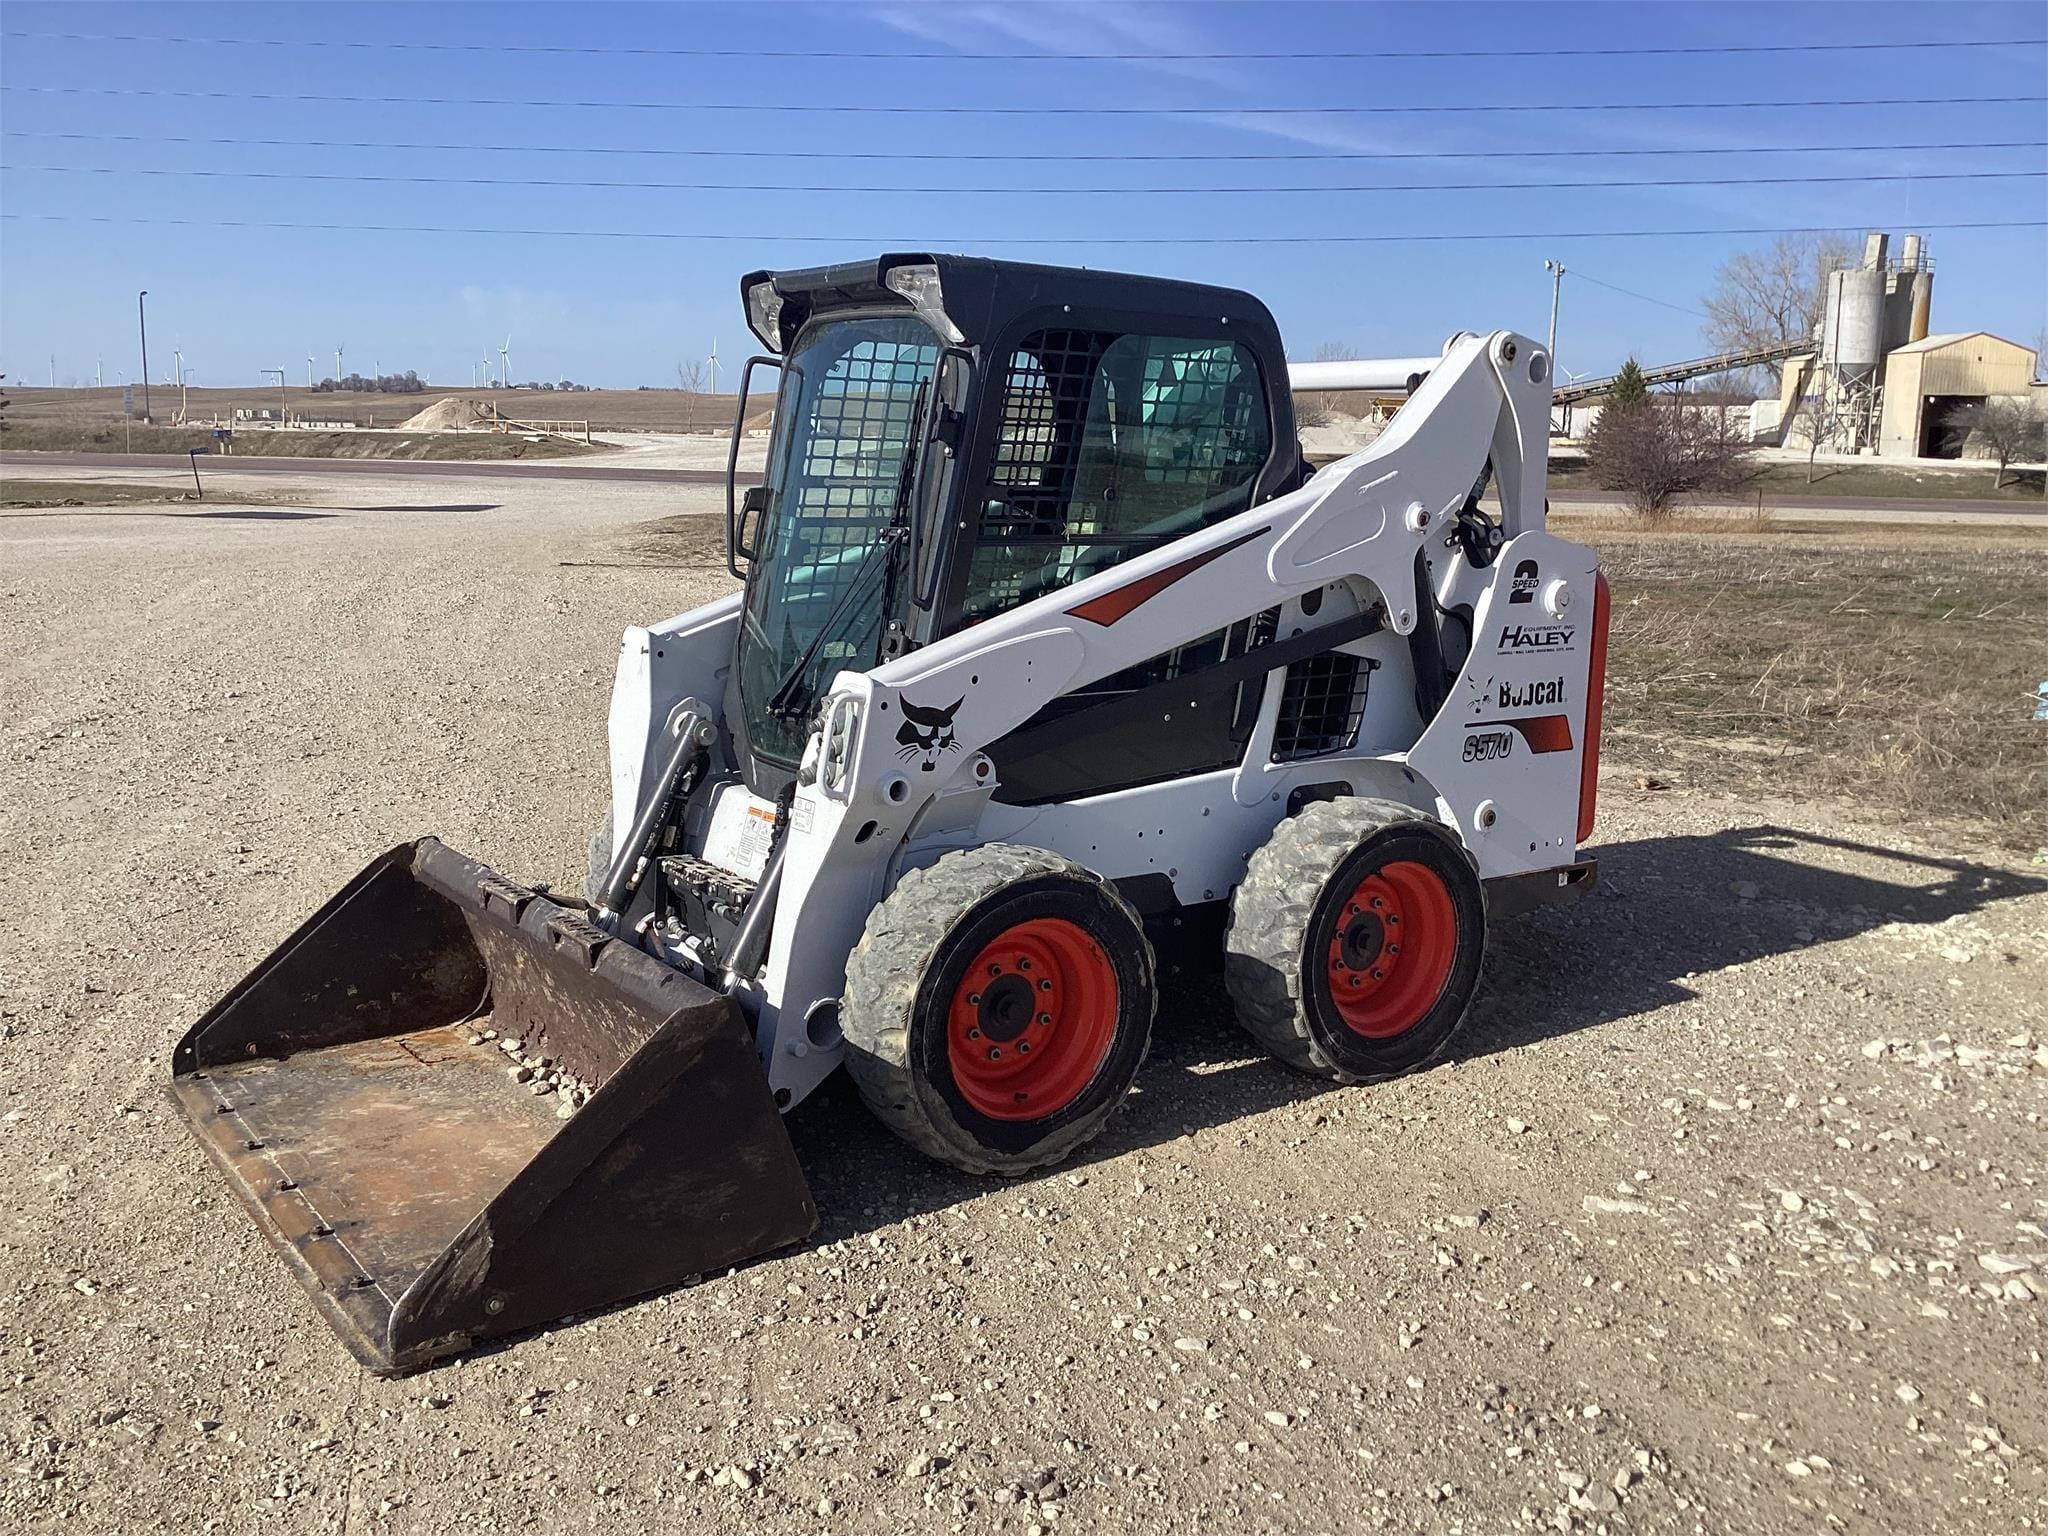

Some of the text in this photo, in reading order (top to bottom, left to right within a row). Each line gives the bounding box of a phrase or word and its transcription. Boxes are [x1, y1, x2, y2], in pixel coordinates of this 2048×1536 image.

[1509, 559, 1538, 604] 2
[1511, 579, 1540, 589] SPEED
[1498, 625, 1575, 648] HALEY
[1523, 624, 1562, 632] EQUIPMENT
[1462, 731, 1513, 763] S570
